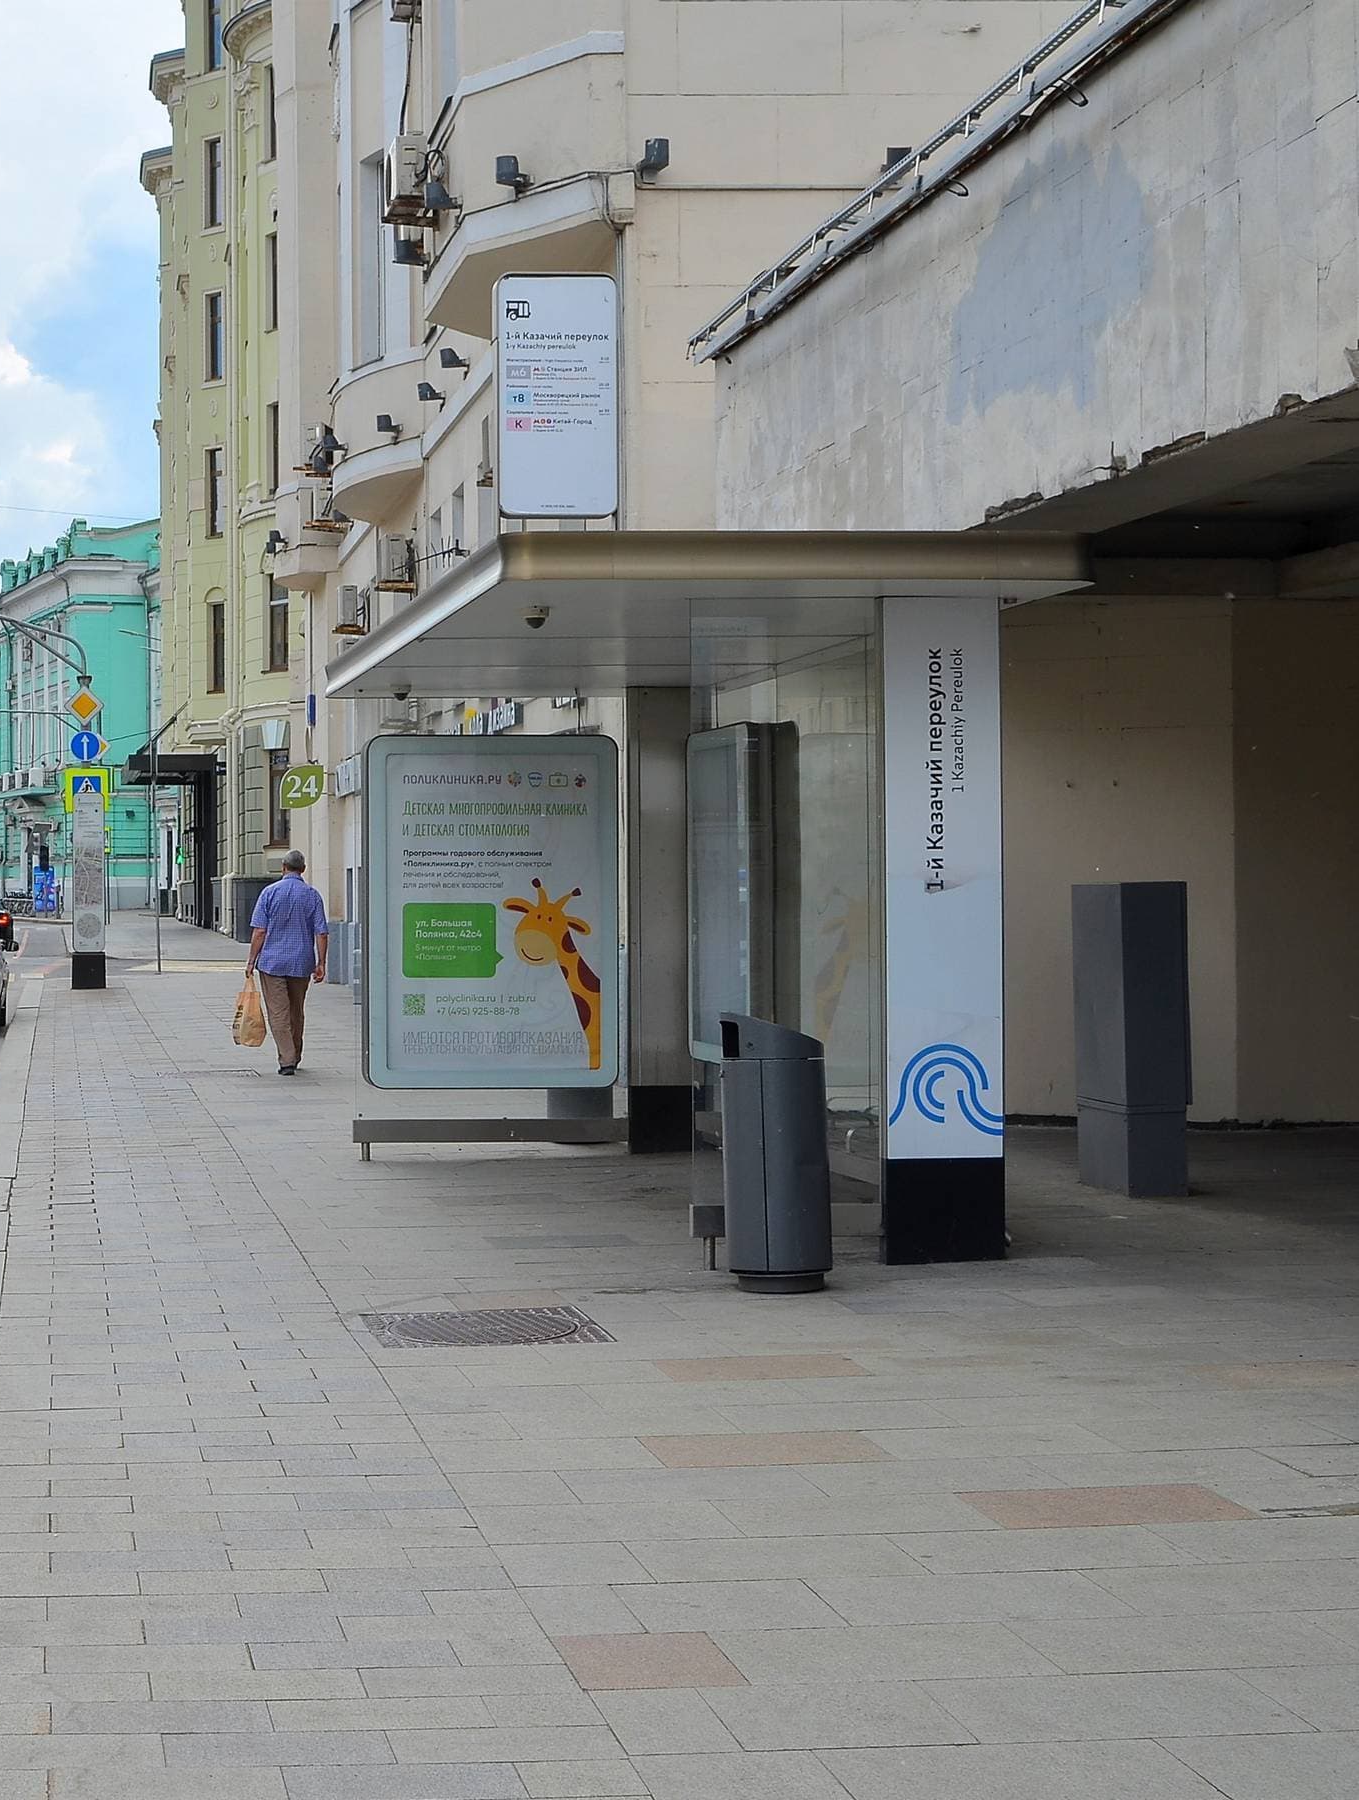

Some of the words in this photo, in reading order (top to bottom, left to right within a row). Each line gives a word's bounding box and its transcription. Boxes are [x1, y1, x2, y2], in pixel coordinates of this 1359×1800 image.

[505, 331, 521, 341] 1-й
[523, 331, 562, 341] Казачий
[564, 333, 609, 343] переулок
[951, 647, 964, 712] Pereulok
[928, 647, 947, 752] переулок
[951, 716, 967, 781] Kazachiy
[286, 775, 318, 798] 24
[952, 785, 964, 793] 1
[449, 802, 542, 816] МНОГОПРОФИЛЬНАЯ
[545, 802, 588, 817] КЛИНИКА
[925, 760, 945, 851] Казачий
[402, 824, 409, 837] И
[413, 823, 455, 837] ДЕТСКАЯ
[459, 823, 530, 837] СТОМАТОЛОГИЯ
[403, 850, 448, 858] Программы
[450, 850, 485, 858] годового
[487, 850, 543, 858] обслуживания
[925, 858, 945, 892] 1-й
[415, 920, 429, 929] ул.
[430, 919, 472, 927] Большая
[415, 930, 458, 939] Полянка,
[459, 930, 482, 938] 42с4
[435, 993, 496, 1004] polyclinika.ru
[507, 994, 536, 1003] zub.ru
[436, 1007, 446, 1016] +7
[447, 1006, 470, 1016] (495)
[472, 1007, 520, 1016] 925-88-78
[402, 1031, 460, 1044] ИМЕЮТСЯ
